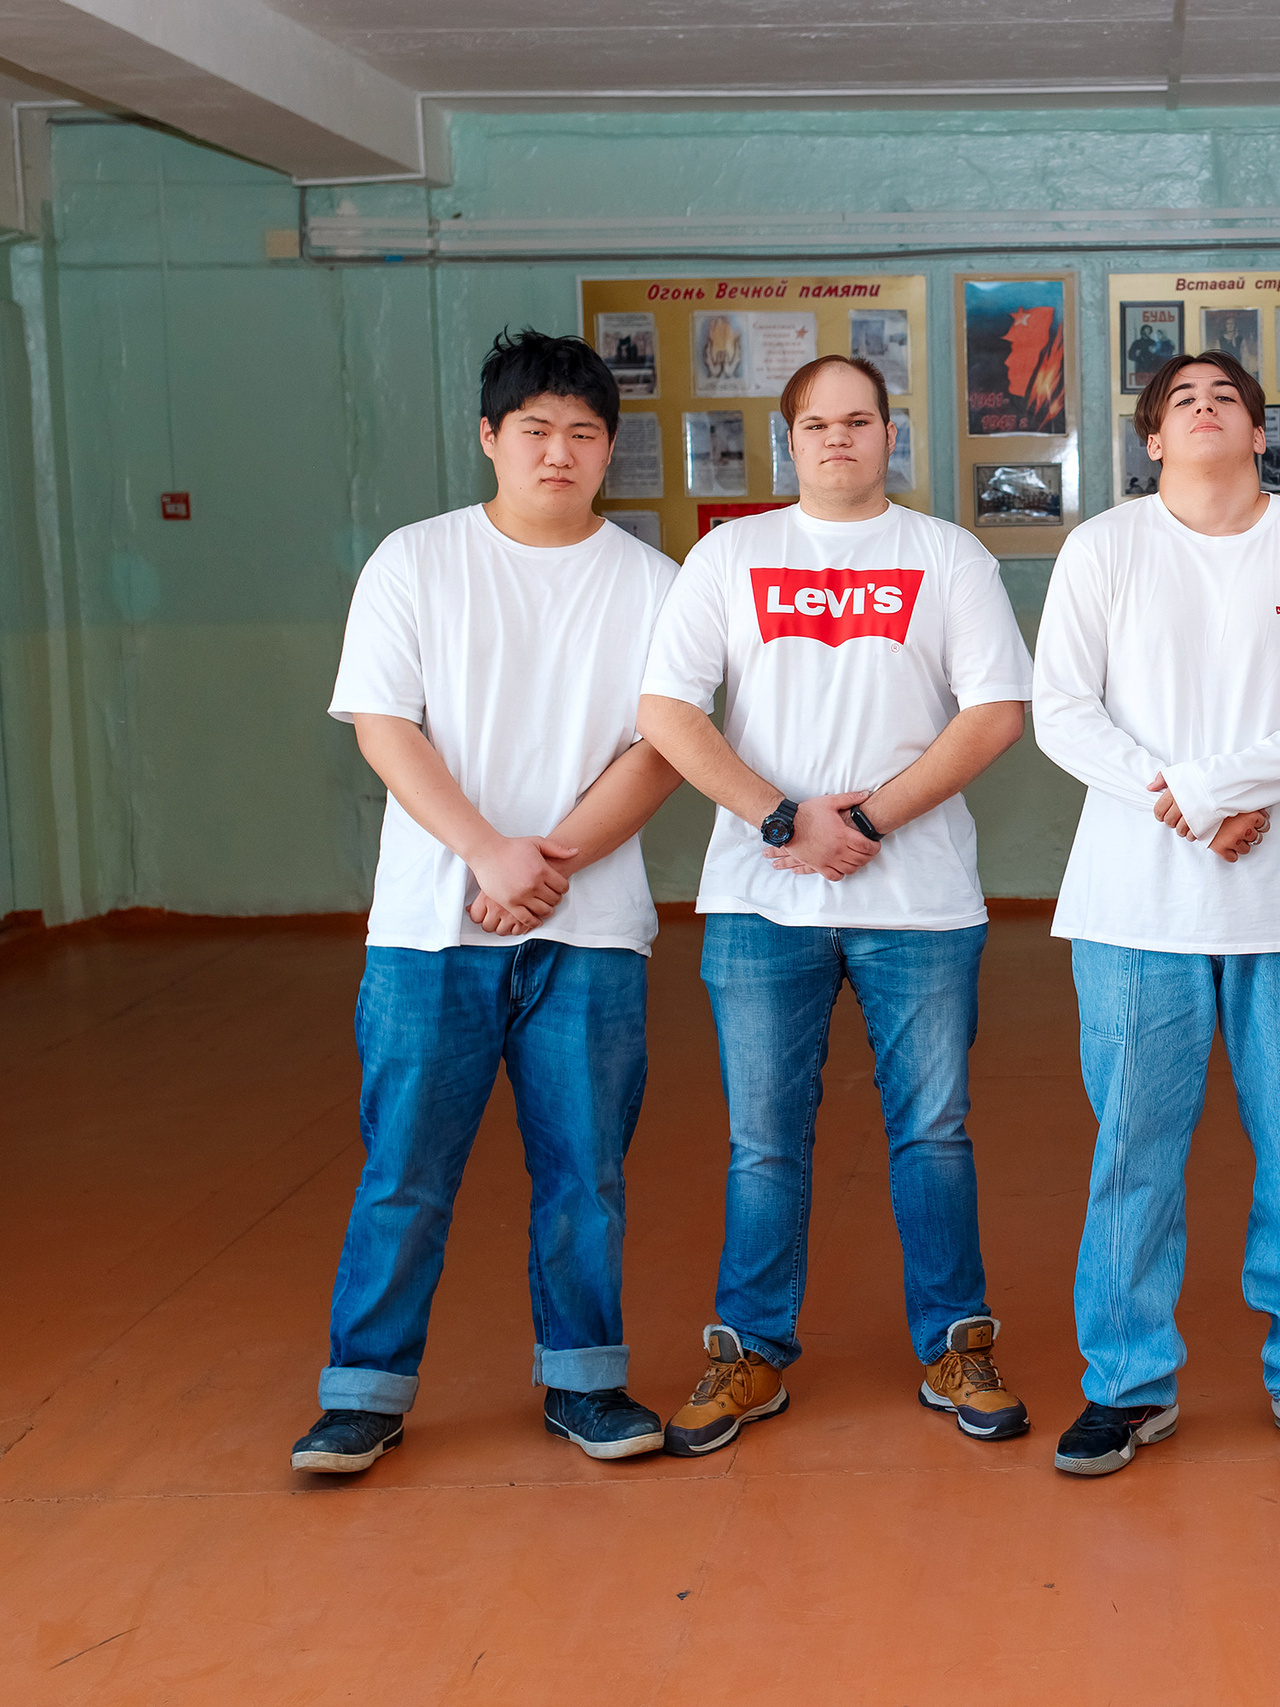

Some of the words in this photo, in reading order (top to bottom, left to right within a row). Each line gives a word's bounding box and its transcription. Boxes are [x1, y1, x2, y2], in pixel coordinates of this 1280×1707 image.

[647, 284, 705, 300] Огонь
[714, 280, 789, 300] Вечной
[799, 283, 881, 299] памяти
[1175, 276, 1246, 292] Вставай
[1142, 310, 1175, 323] БУДЬ
